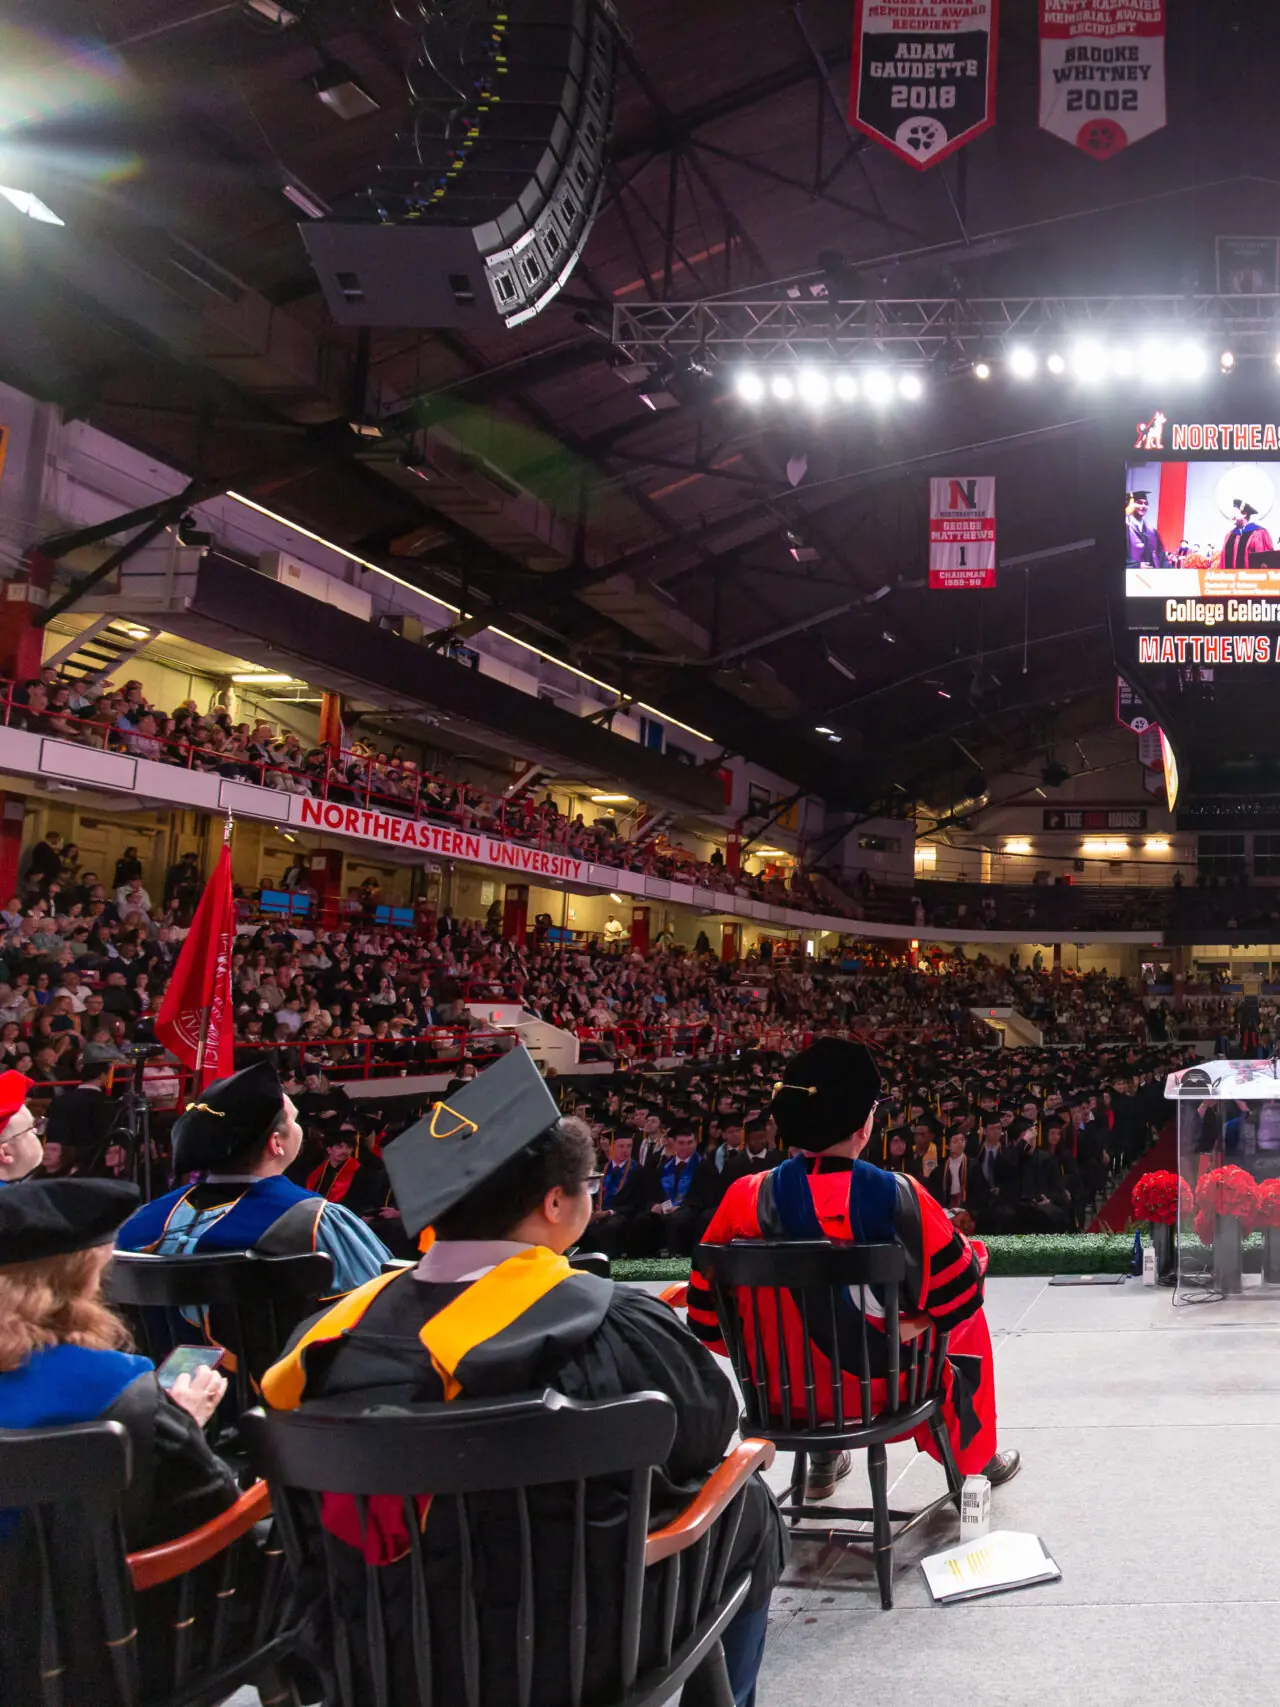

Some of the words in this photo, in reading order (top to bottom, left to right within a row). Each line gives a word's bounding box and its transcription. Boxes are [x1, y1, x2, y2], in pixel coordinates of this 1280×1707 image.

[868, 6, 937, 17] MEMORIAL
[941, 5, 986, 17] AWARD
[1045, 0, 1087, 11] PATTY
[892, 19, 962, 30] RECIPIENT
[1044, 10, 1112, 23] MEMORIAL
[1115, 9, 1161, 21] AWARD
[1069, 22, 1137, 36] RECIPIENT
[894, 43, 955, 59] ADAM
[1064, 45, 1139, 63] BROOKE
[870, 60, 978, 79] GAUDETTE
[1052, 64, 1152, 84] WHITNEY
[890, 85, 957, 110] 2018
[1066, 89, 1139, 112] 2002
[948, 479, 977, 509] N
[943, 521, 982, 531] GEORGE
[931, 530, 994, 540] MATTHEWS
[959, 546, 967, 566] 1
[939, 570, 986, 579] CHAIRMAN
[1166, 599, 1224, 626] College
[1138, 635, 1269, 663] MATTHEWS
[1064, 812, 1083, 828] THE
[1108, 811, 1141, 828] HOUSE
[301, 798, 480, 858] NORTHEASTERN
[488, 843, 582, 879] UNIVERSITY
